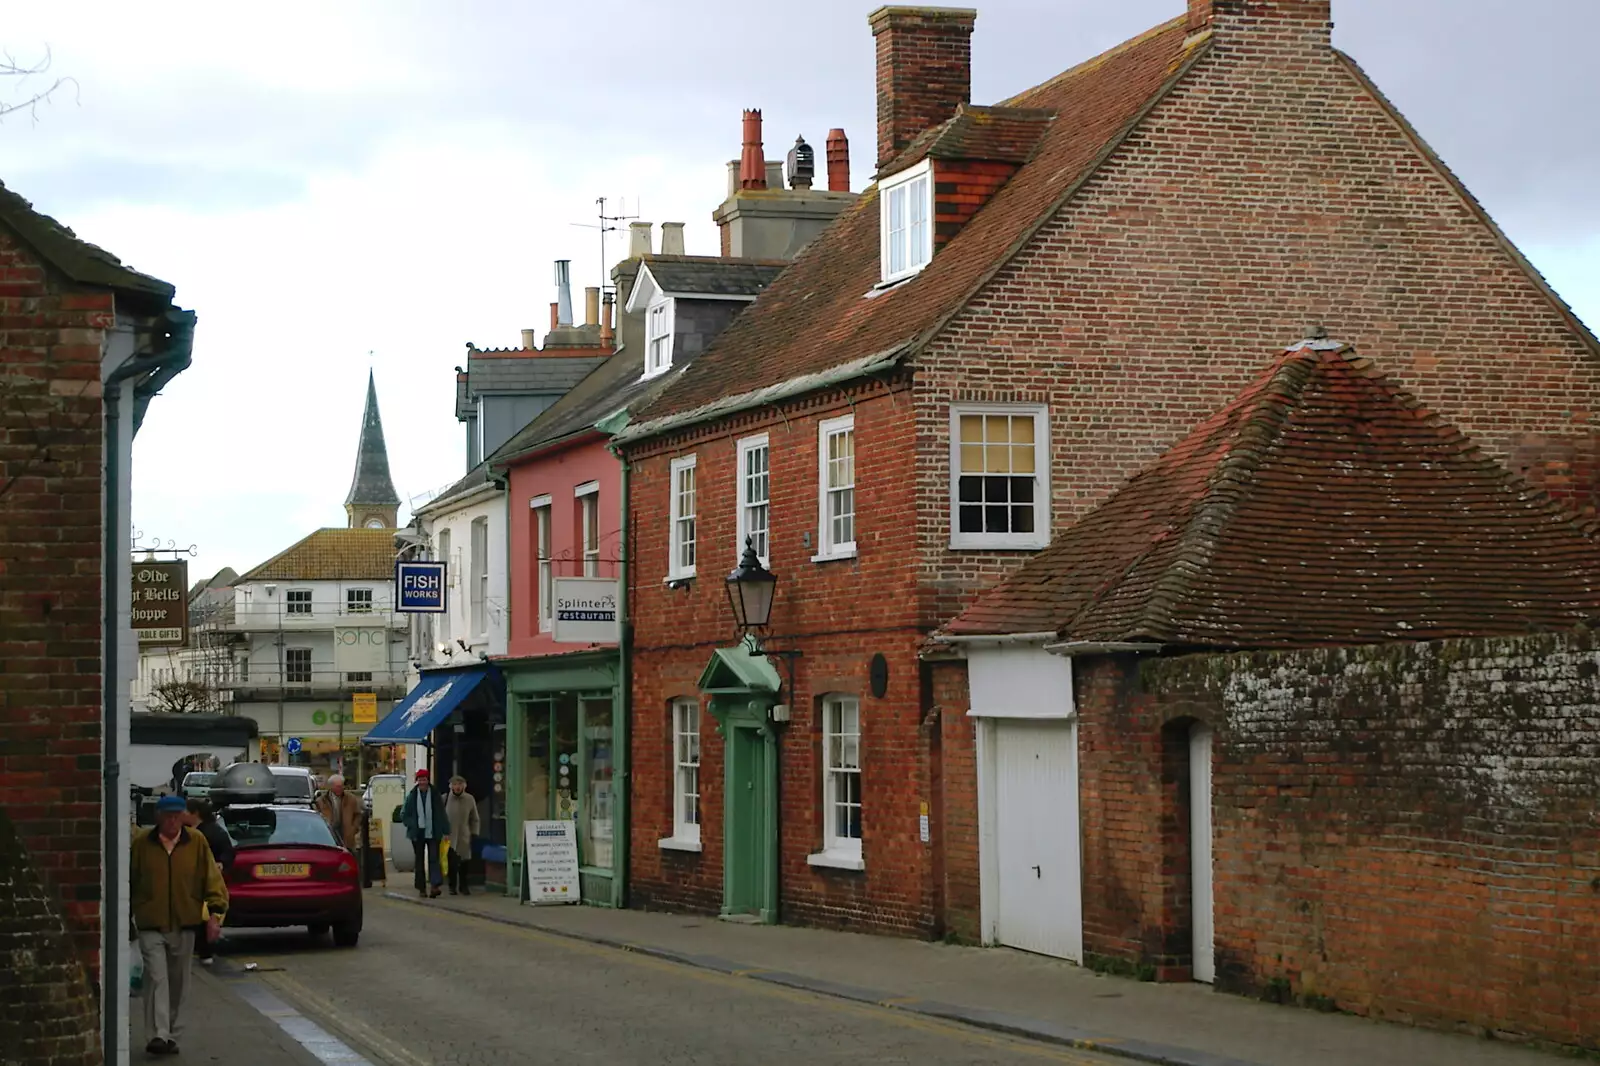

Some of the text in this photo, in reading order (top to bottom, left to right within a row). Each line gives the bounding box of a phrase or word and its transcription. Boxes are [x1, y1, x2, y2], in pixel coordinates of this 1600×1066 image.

[138, 570, 169, 582] Olde
[404, 575, 439, 589] FISH
[144, 588, 180, 602] Bells
[404, 590, 438, 598] WORKS
[132, 607, 168, 620] hoppe
[558, 611, 616, 620] restaurant
[159, 629, 179, 638] GIFTS
